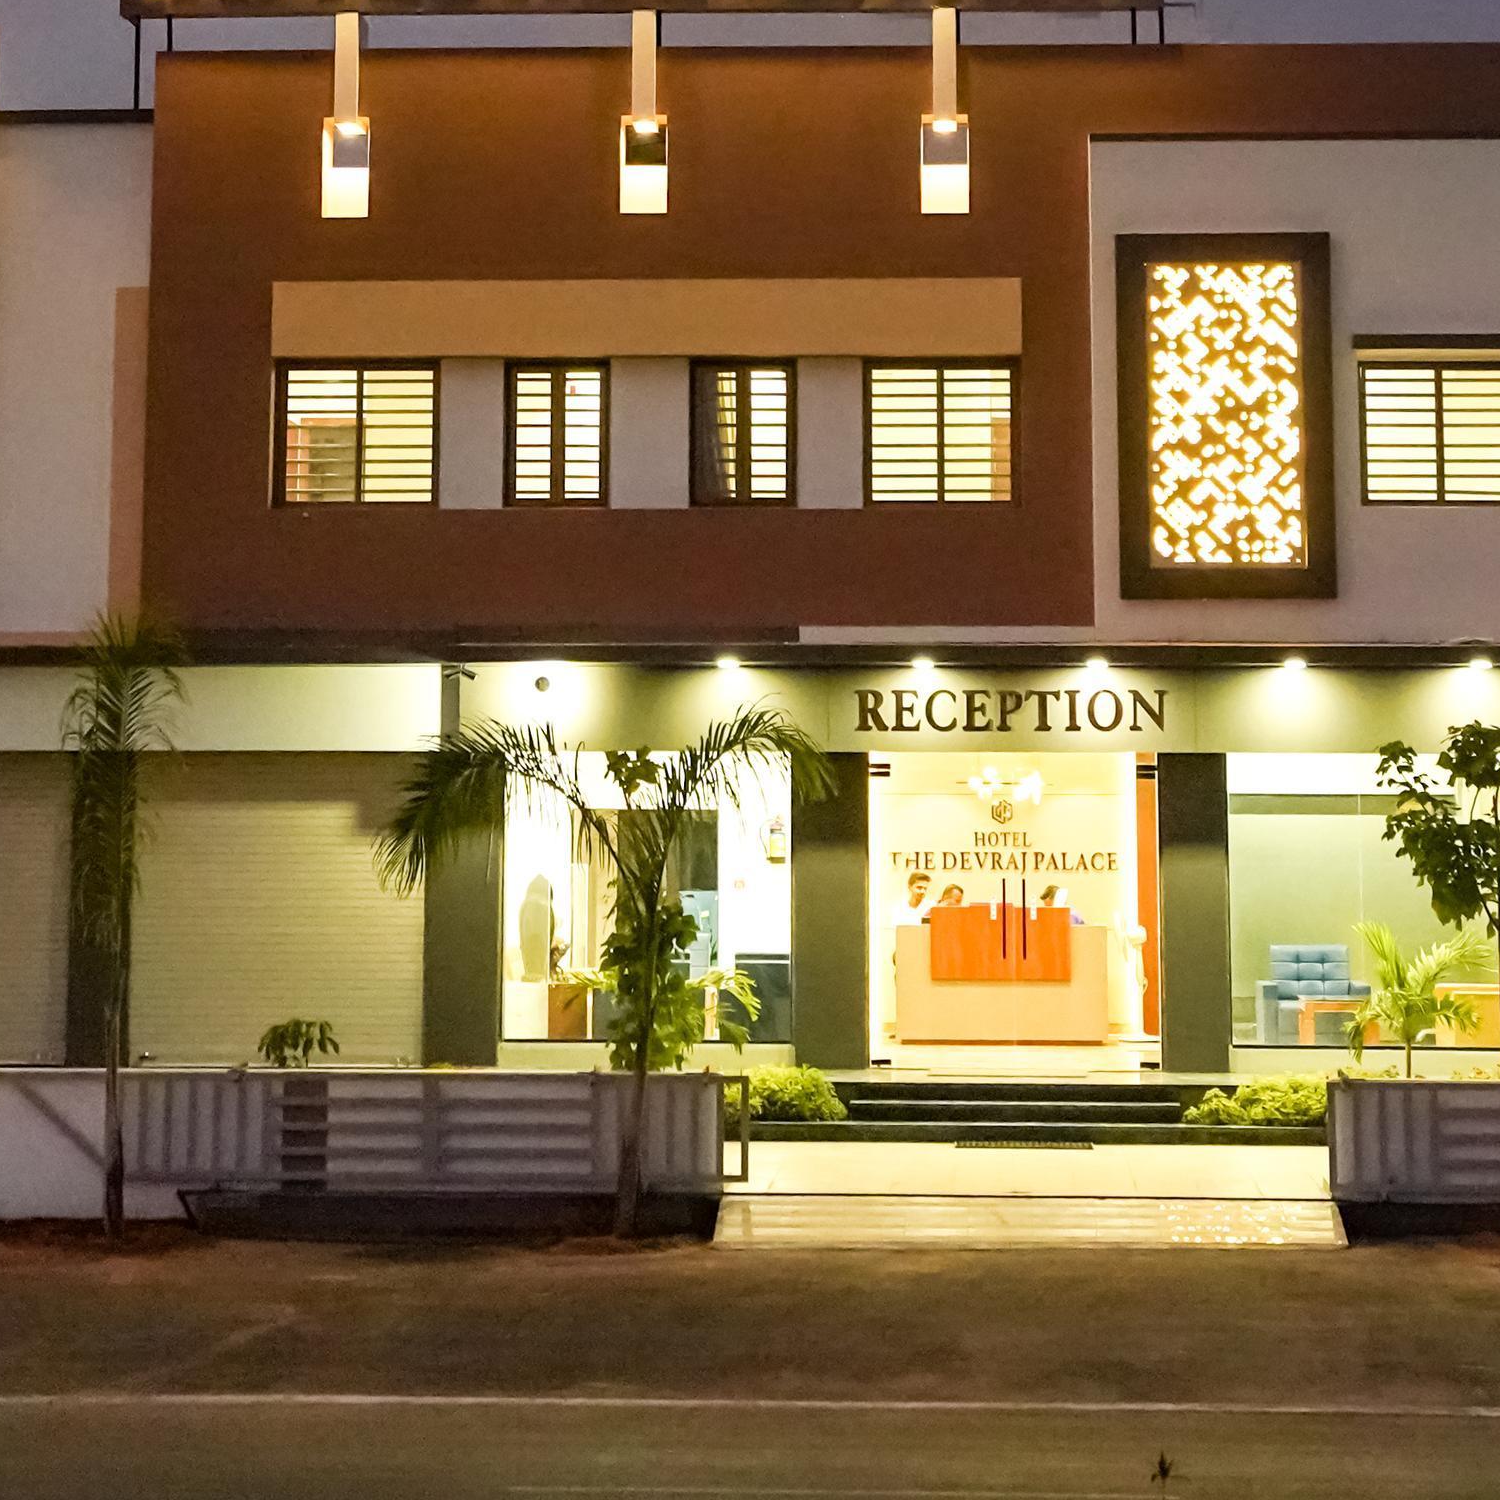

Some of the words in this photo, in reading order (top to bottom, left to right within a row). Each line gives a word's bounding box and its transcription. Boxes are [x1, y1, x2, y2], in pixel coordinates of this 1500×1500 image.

[854, 689, 1169, 732] RECEPTION
[974, 831, 1032, 848] HOTEL
[942, 851, 1028, 875] DEVRAJ
[1033, 851, 1119, 871] PALACE
